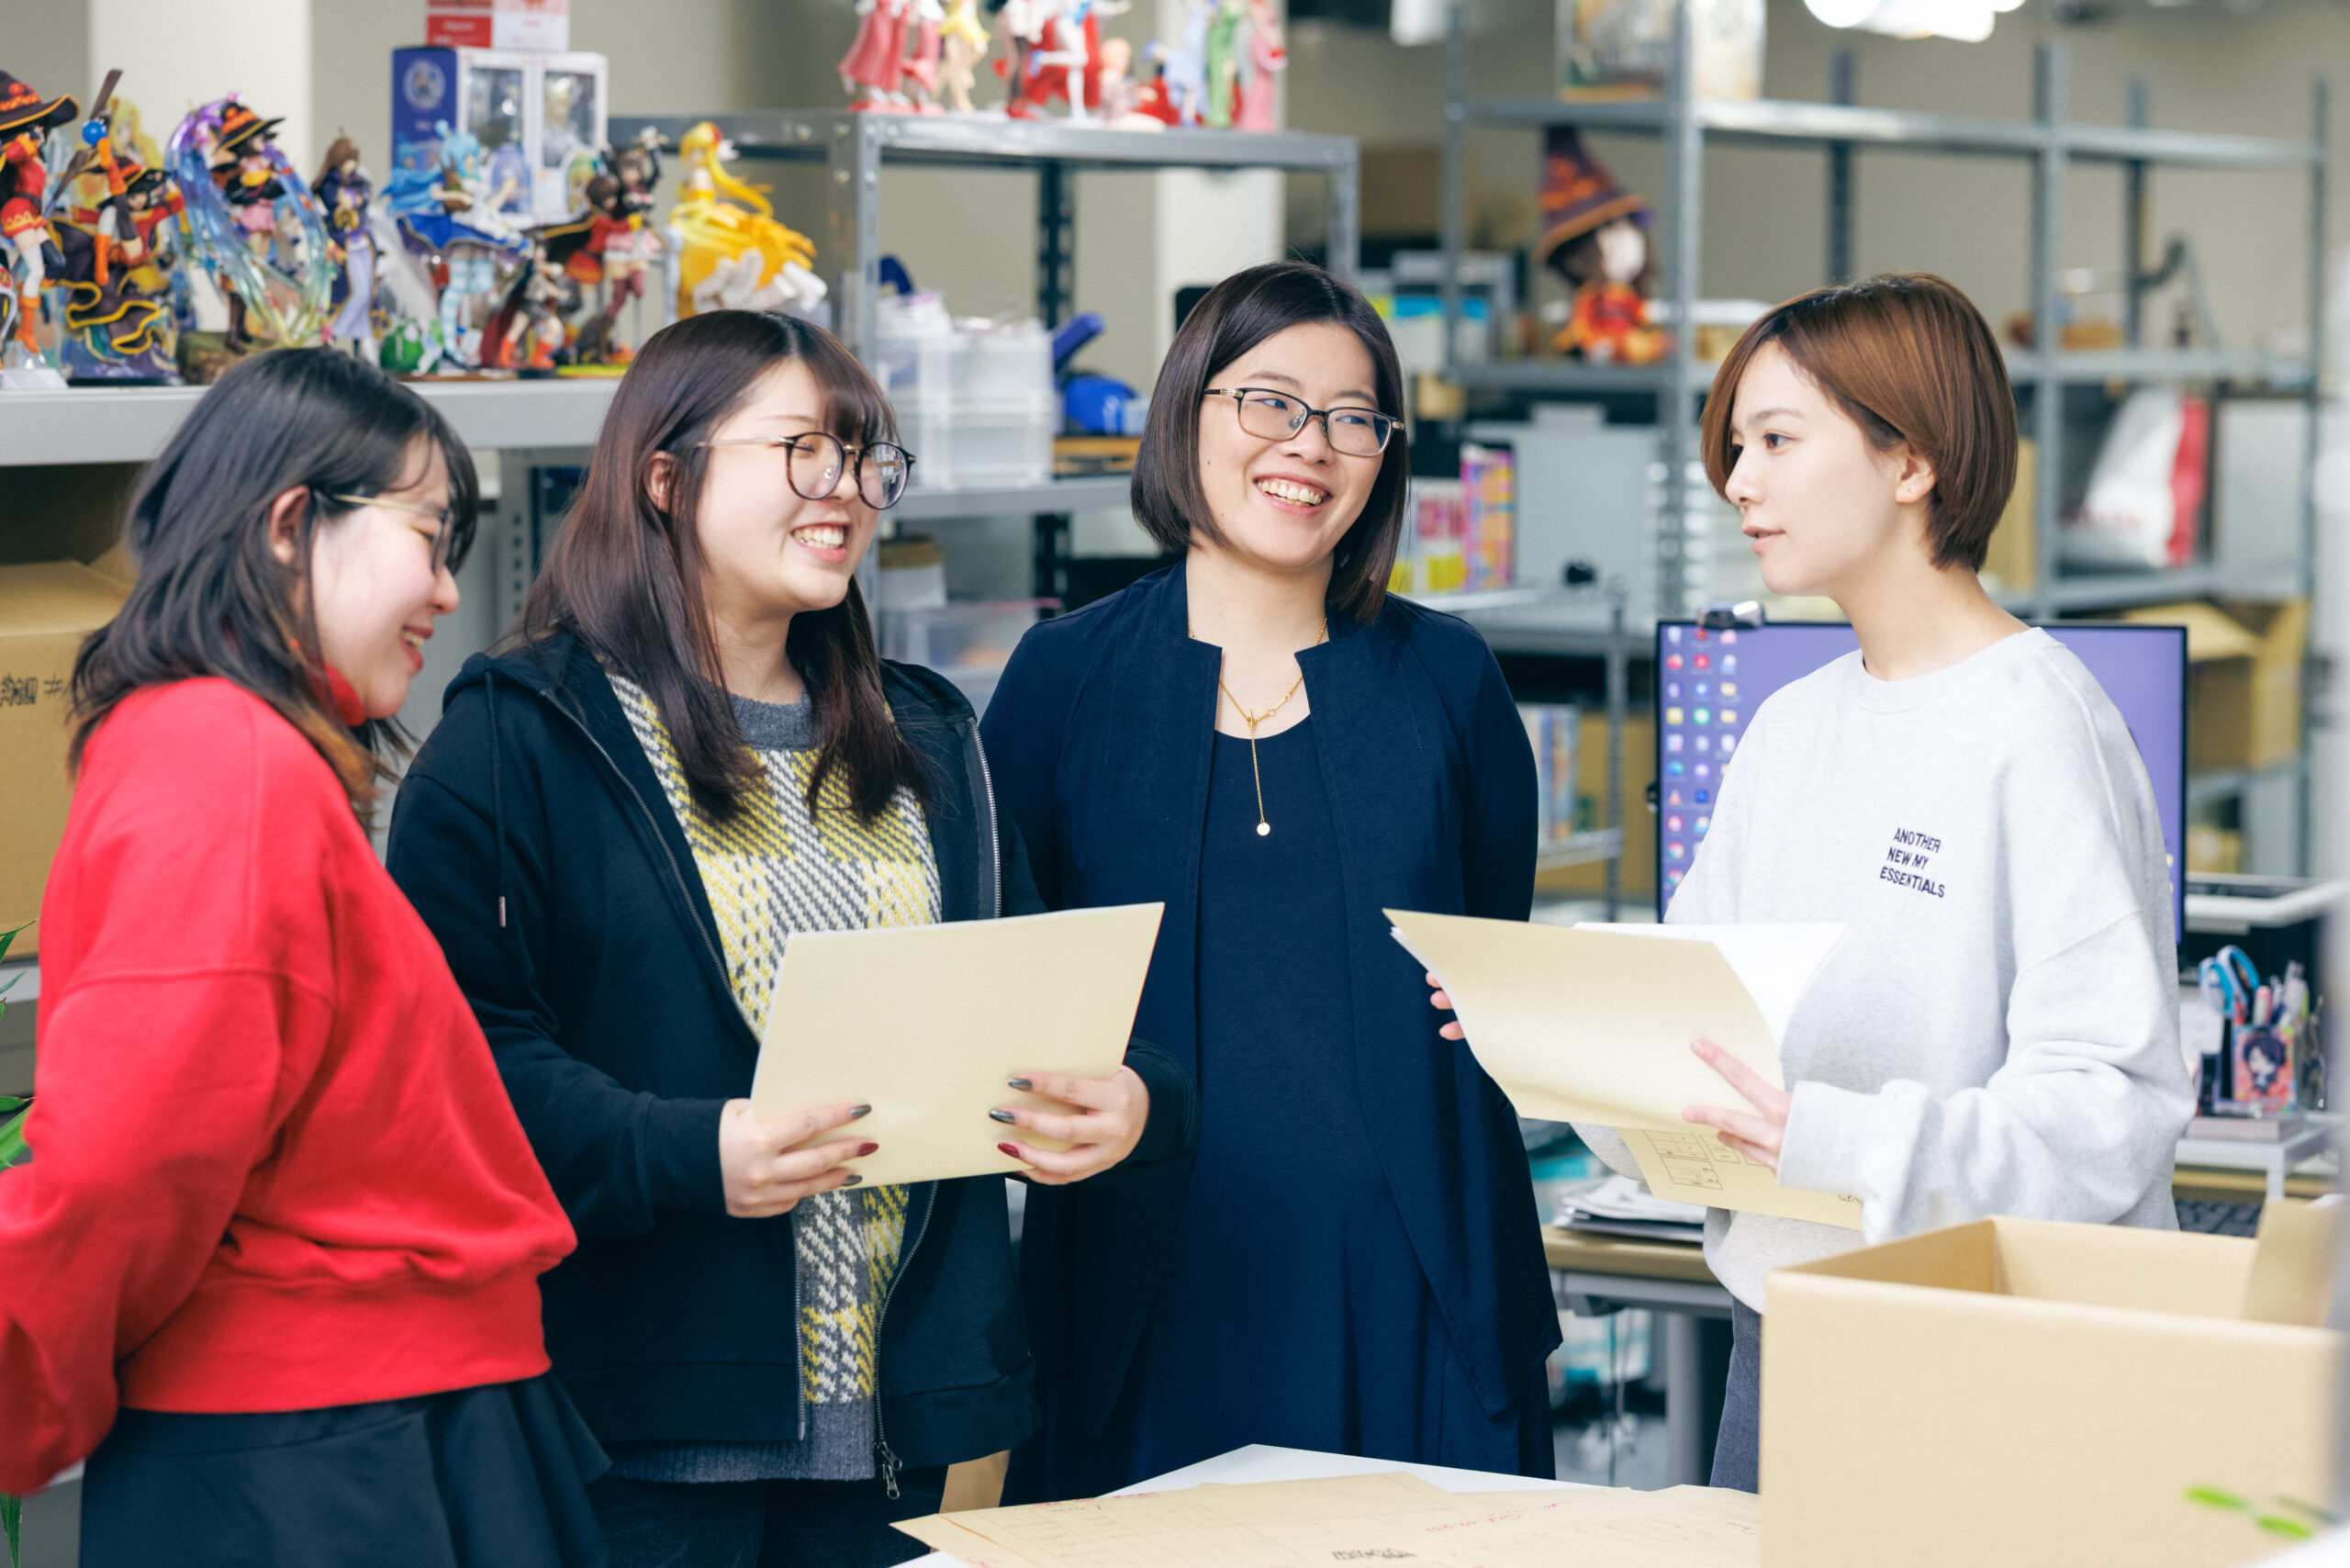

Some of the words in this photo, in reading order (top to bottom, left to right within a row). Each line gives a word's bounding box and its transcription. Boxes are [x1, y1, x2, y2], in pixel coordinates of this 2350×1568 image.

[1894, 827, 1942, 853] ANOTHER
[1887, 846, 1912, 866] NEW
[1911, 854, 1929, 869] MY
[1880, 867, 1945, 898] ESSENTIALS
